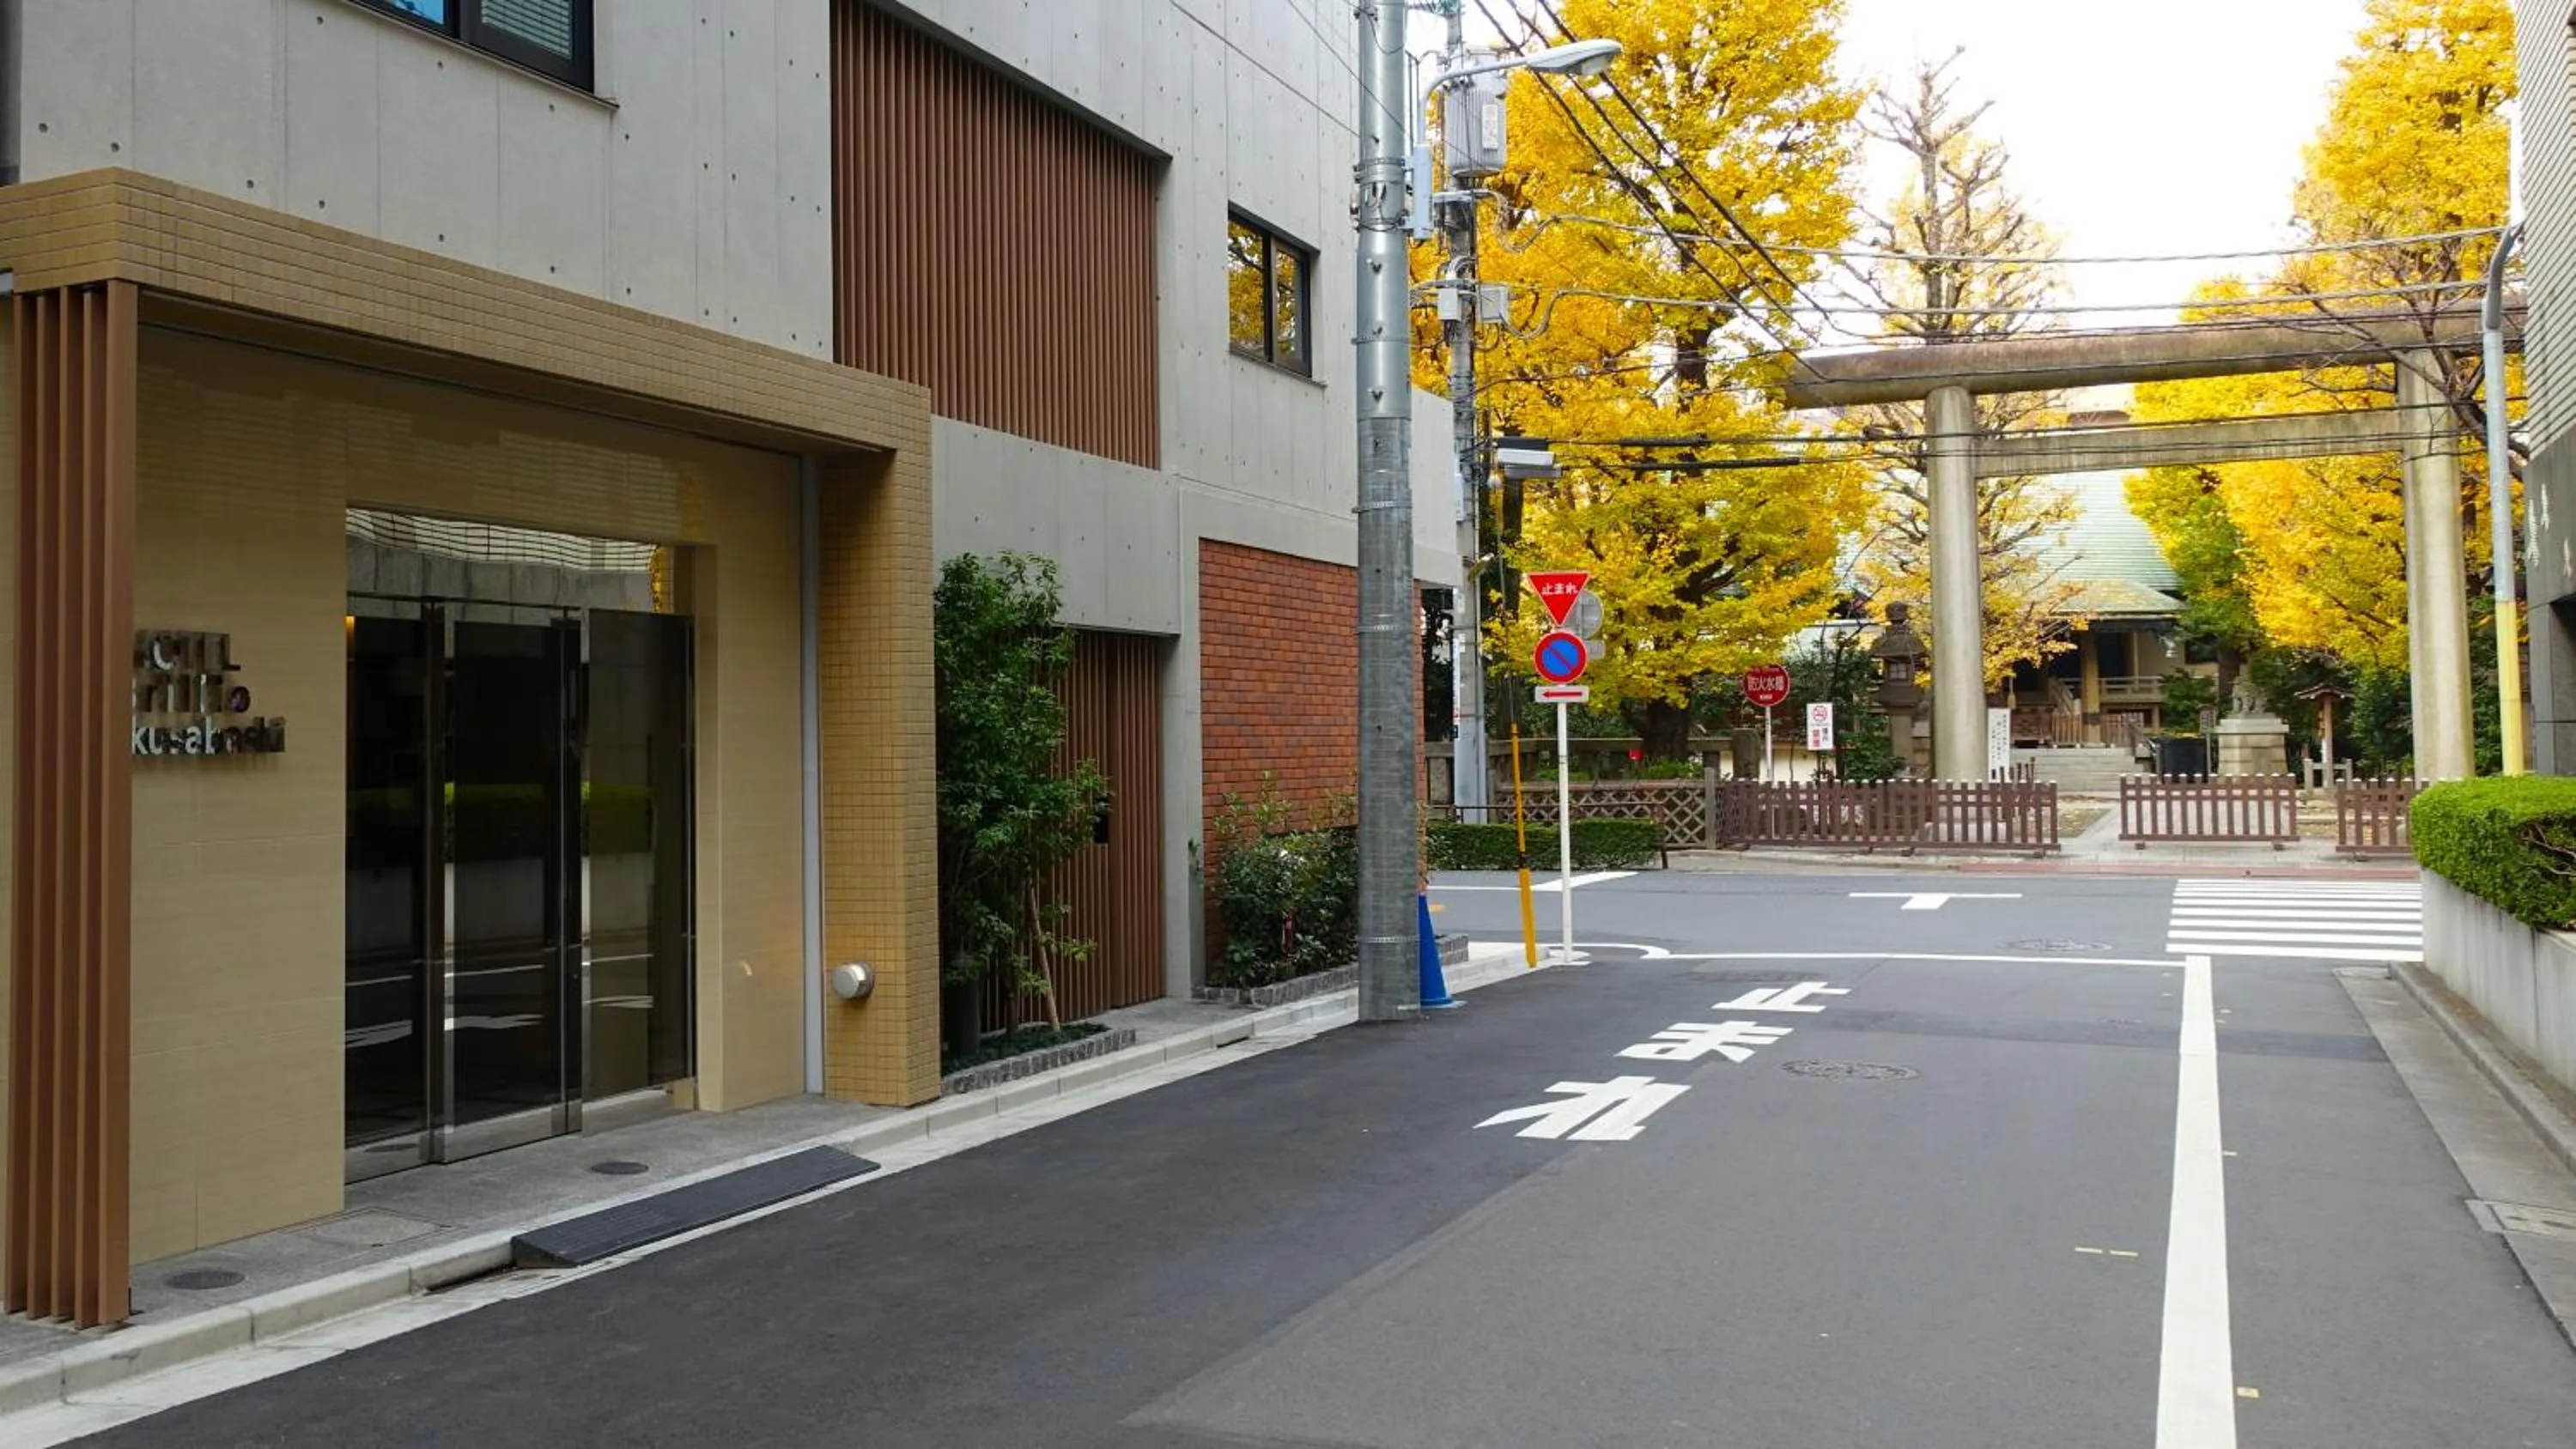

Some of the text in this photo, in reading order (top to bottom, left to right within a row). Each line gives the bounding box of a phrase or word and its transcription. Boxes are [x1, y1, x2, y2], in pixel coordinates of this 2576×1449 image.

[1541, 582, 1577, 595] 止まれ
[131, 714, 287, 755] kusabashi
[1473, 981, 1852, 1141] 止まれ
